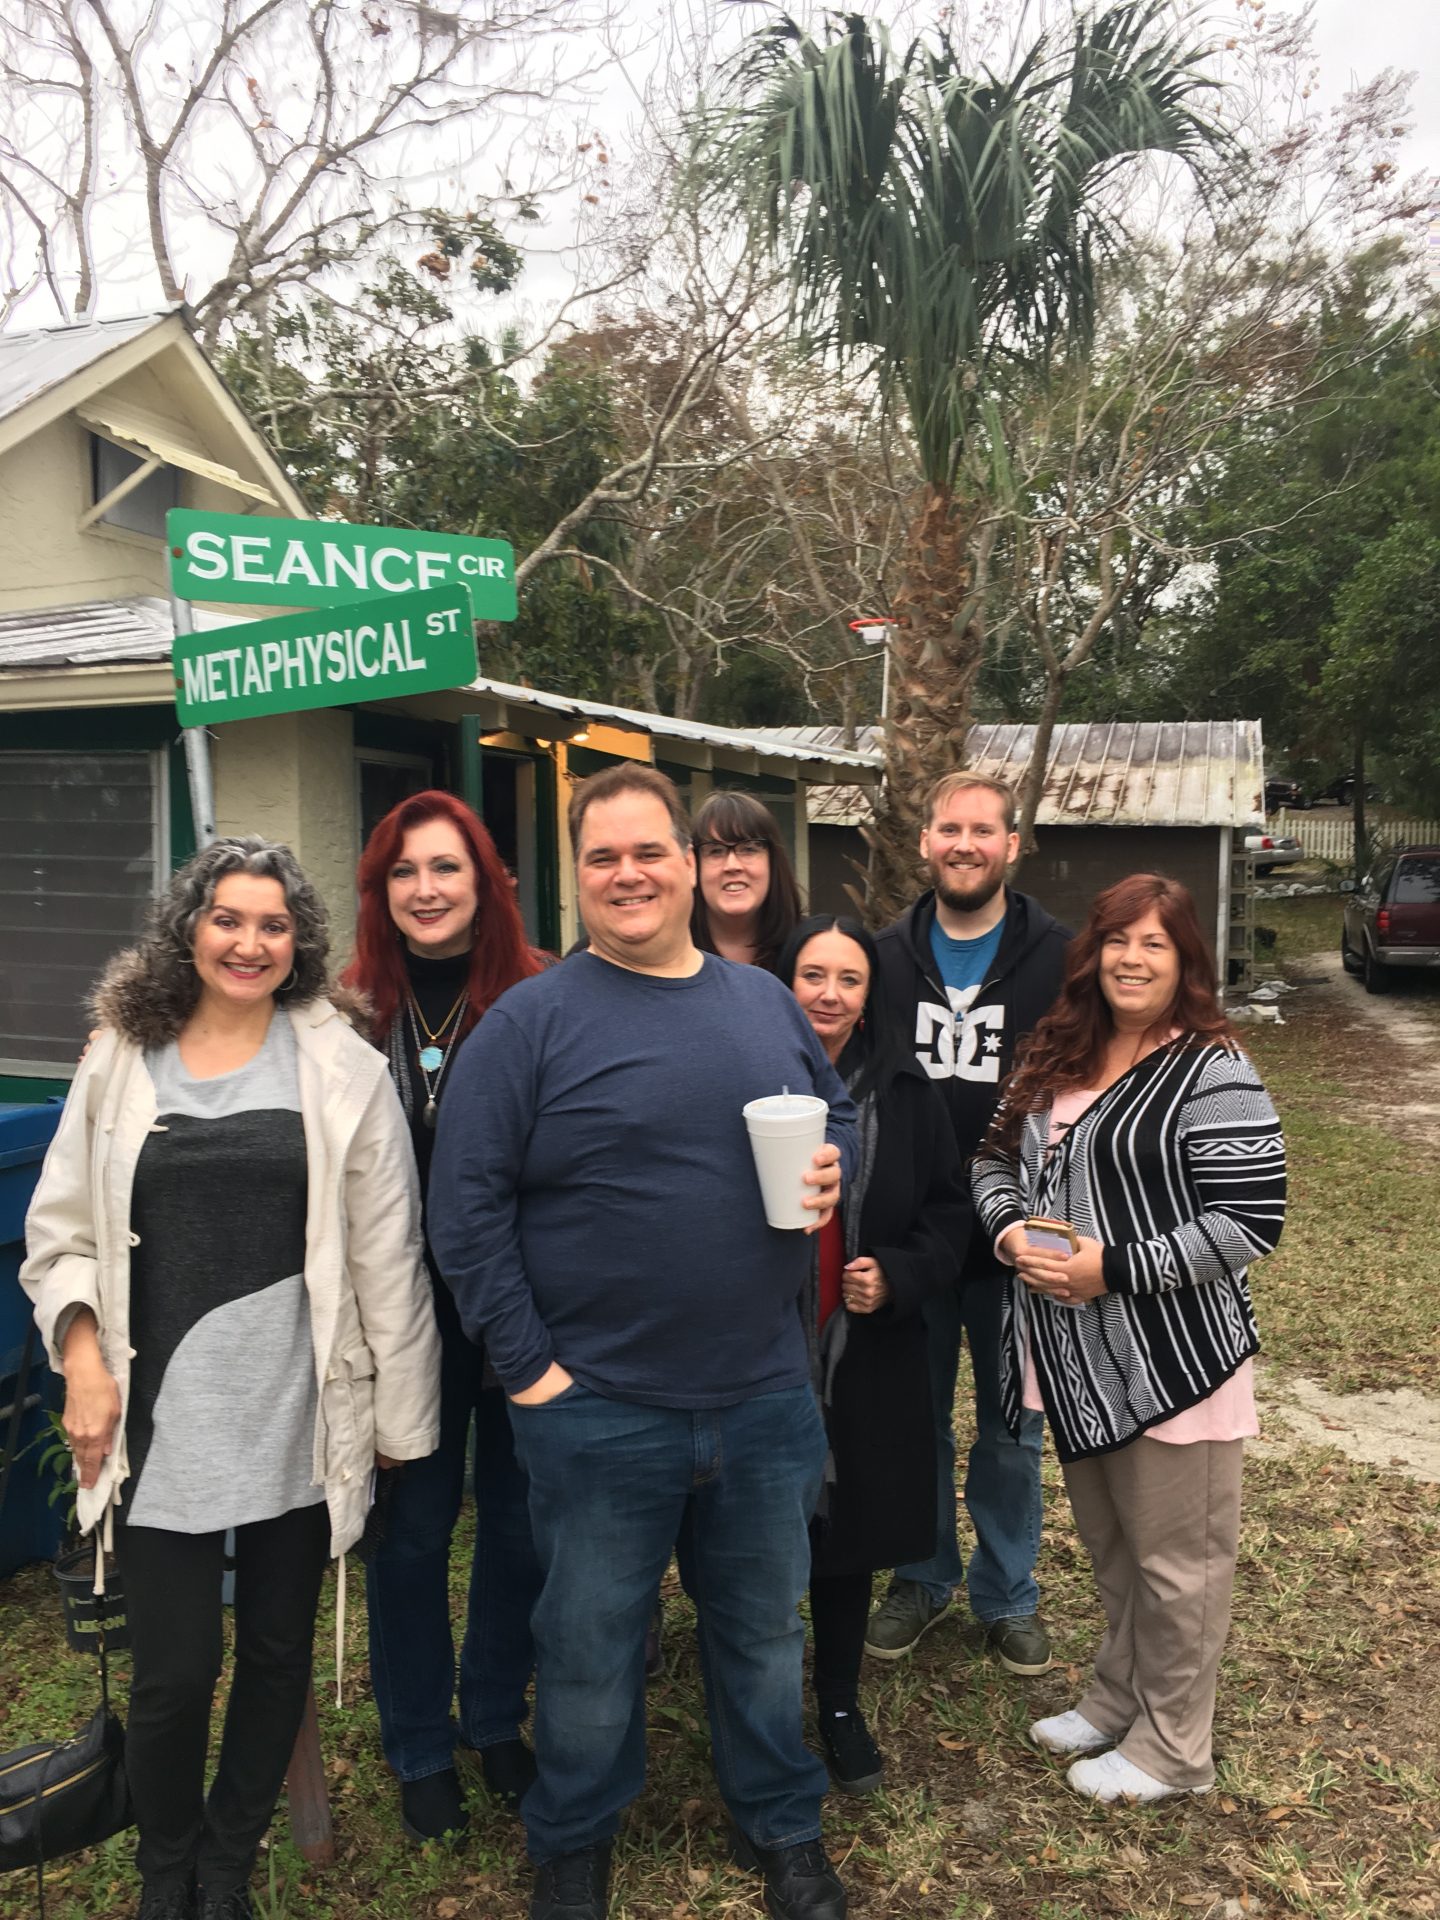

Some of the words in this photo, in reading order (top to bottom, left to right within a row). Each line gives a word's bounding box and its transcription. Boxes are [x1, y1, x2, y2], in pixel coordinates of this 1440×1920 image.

[457, 554, 506, 579] CIR
[182, 619, 427, 705] METAPHYSICAL
[425, 608, 462, 636] ST
[73, 1614, 127, 1633] LEON
